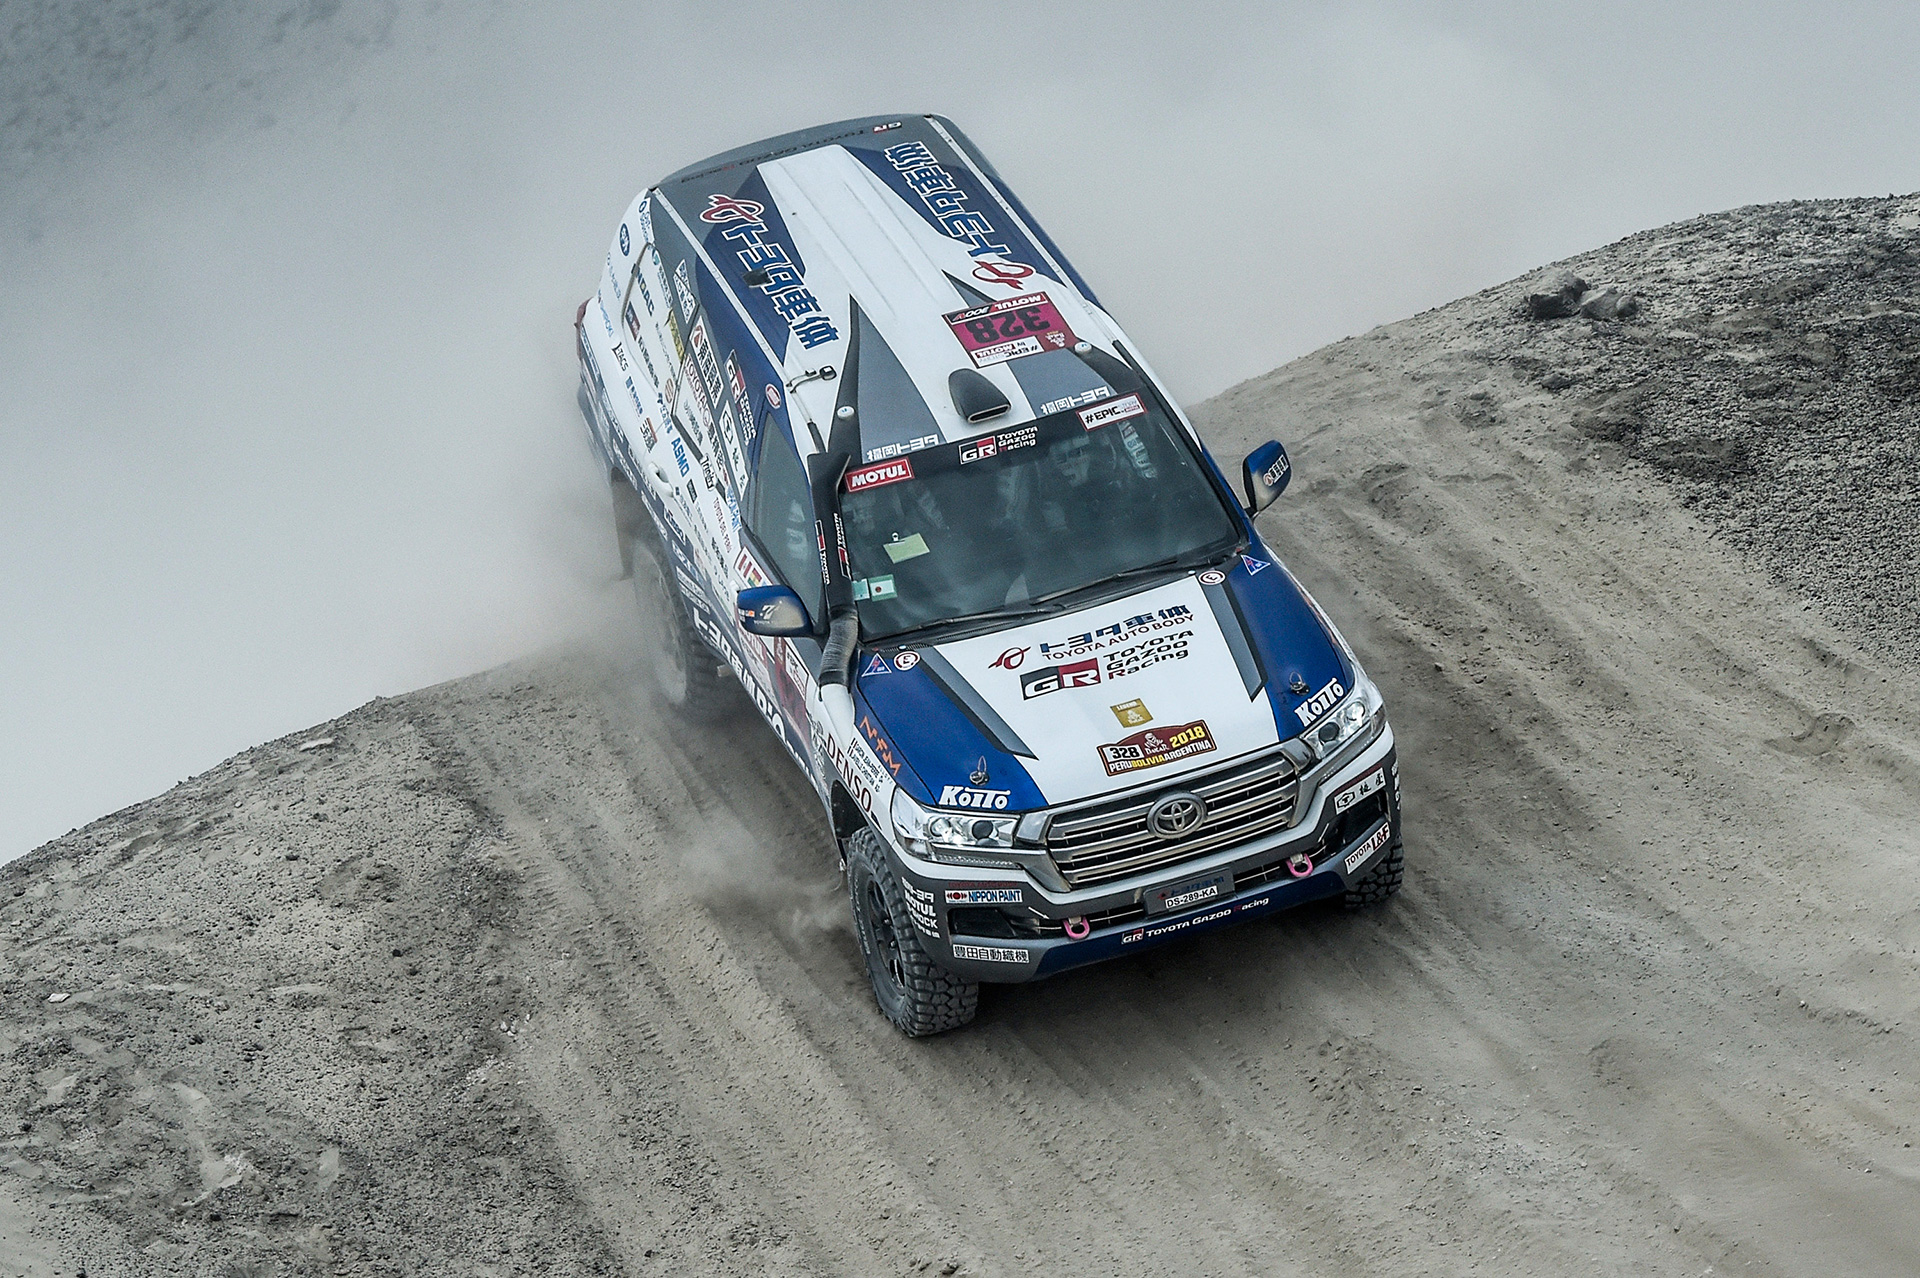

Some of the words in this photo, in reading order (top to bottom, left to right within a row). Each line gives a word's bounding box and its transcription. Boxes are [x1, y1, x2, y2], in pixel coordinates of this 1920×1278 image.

[994, 295, 1042, 310] MOTUL
[964, 306, 1051, 344] 328
[978, 344, 1014, 358] MOTUL
[960, 440, 996, 463] GR
[997, 426, 1038, 441] TOYOTA
[998, 433, 1036, 447] GAZOO
[999, 439, 1036, 452] Racing
[671, 437, 690, 477] ASMO
[851, 464, 906, 487] MOTUL
[1040, 605, 1191, 653] トヨタ車体
[1042, 642, 1105, 660] TOYOTA
[1109, 626, 1150, 645] AUTO
[1152, 614, 1194, 630] BODY
[1023, 665, 1100, 699] GR
[1103, 630, 1194, 661] TOYOTA
[1106, 640, 1188, 671] GAZOO
[1108, 649, 1189, 680] Racing
[1110, 747, 1140, 759] 328
[1170, 726, 1206, 747] 2018
[827, 733, 871, 813] DENSO
[1347, 843, 1372, 867] TOYOTA
[1371, 825, 1389, 851] L&F
[969, 890, 998, 902] NIPPON
[998, 890, 1021, 902] PAINT
[1166, 887, 1217, 907] DS-289-KA
[1123, 931, 1143, 944] GR
[1146, 921, 1190, 938] TOYOTA
[1192, 909, 1231, 925] GAZOO
[1233, 898, 1269, 912] Racing
